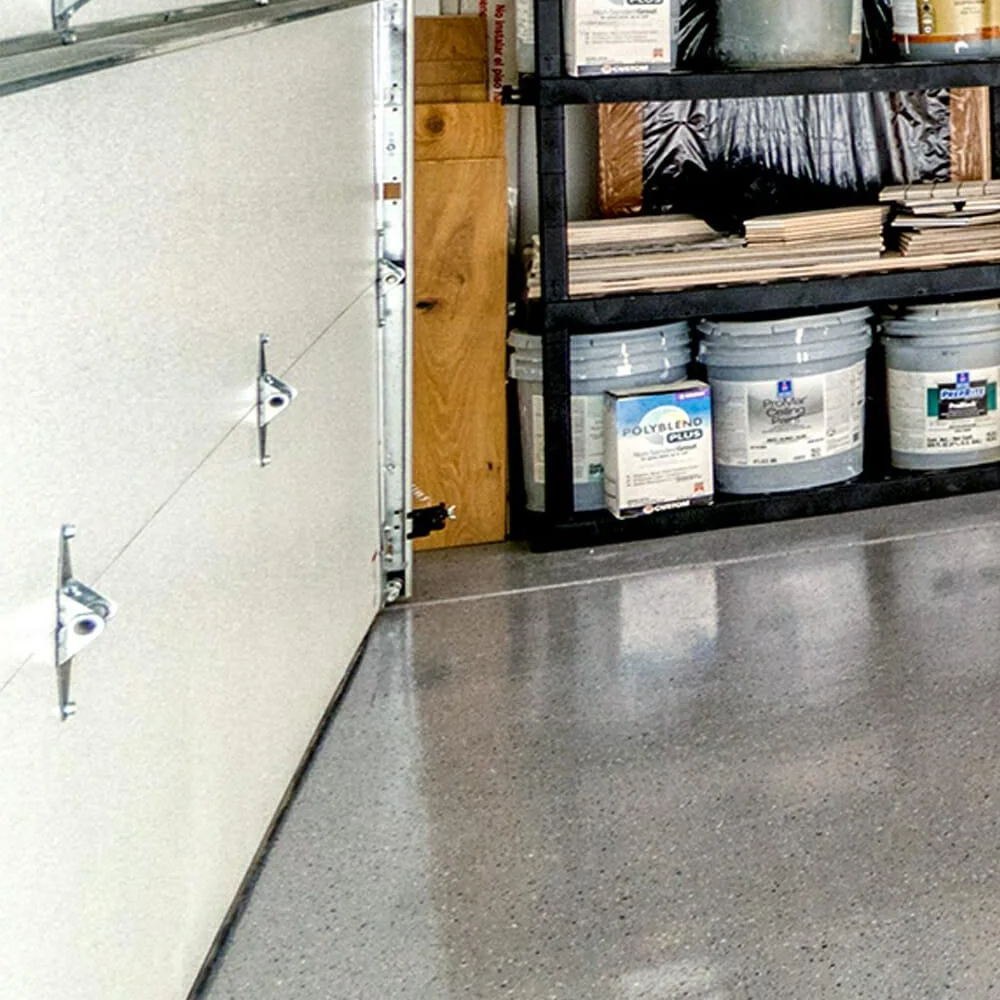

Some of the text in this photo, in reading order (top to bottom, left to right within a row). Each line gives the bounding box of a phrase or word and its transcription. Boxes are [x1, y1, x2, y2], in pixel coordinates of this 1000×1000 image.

[494, 3, 506, 18] No
[622, 416, 703, 437] POLYBLEND
[668, 429, 701, 442] PLUS
